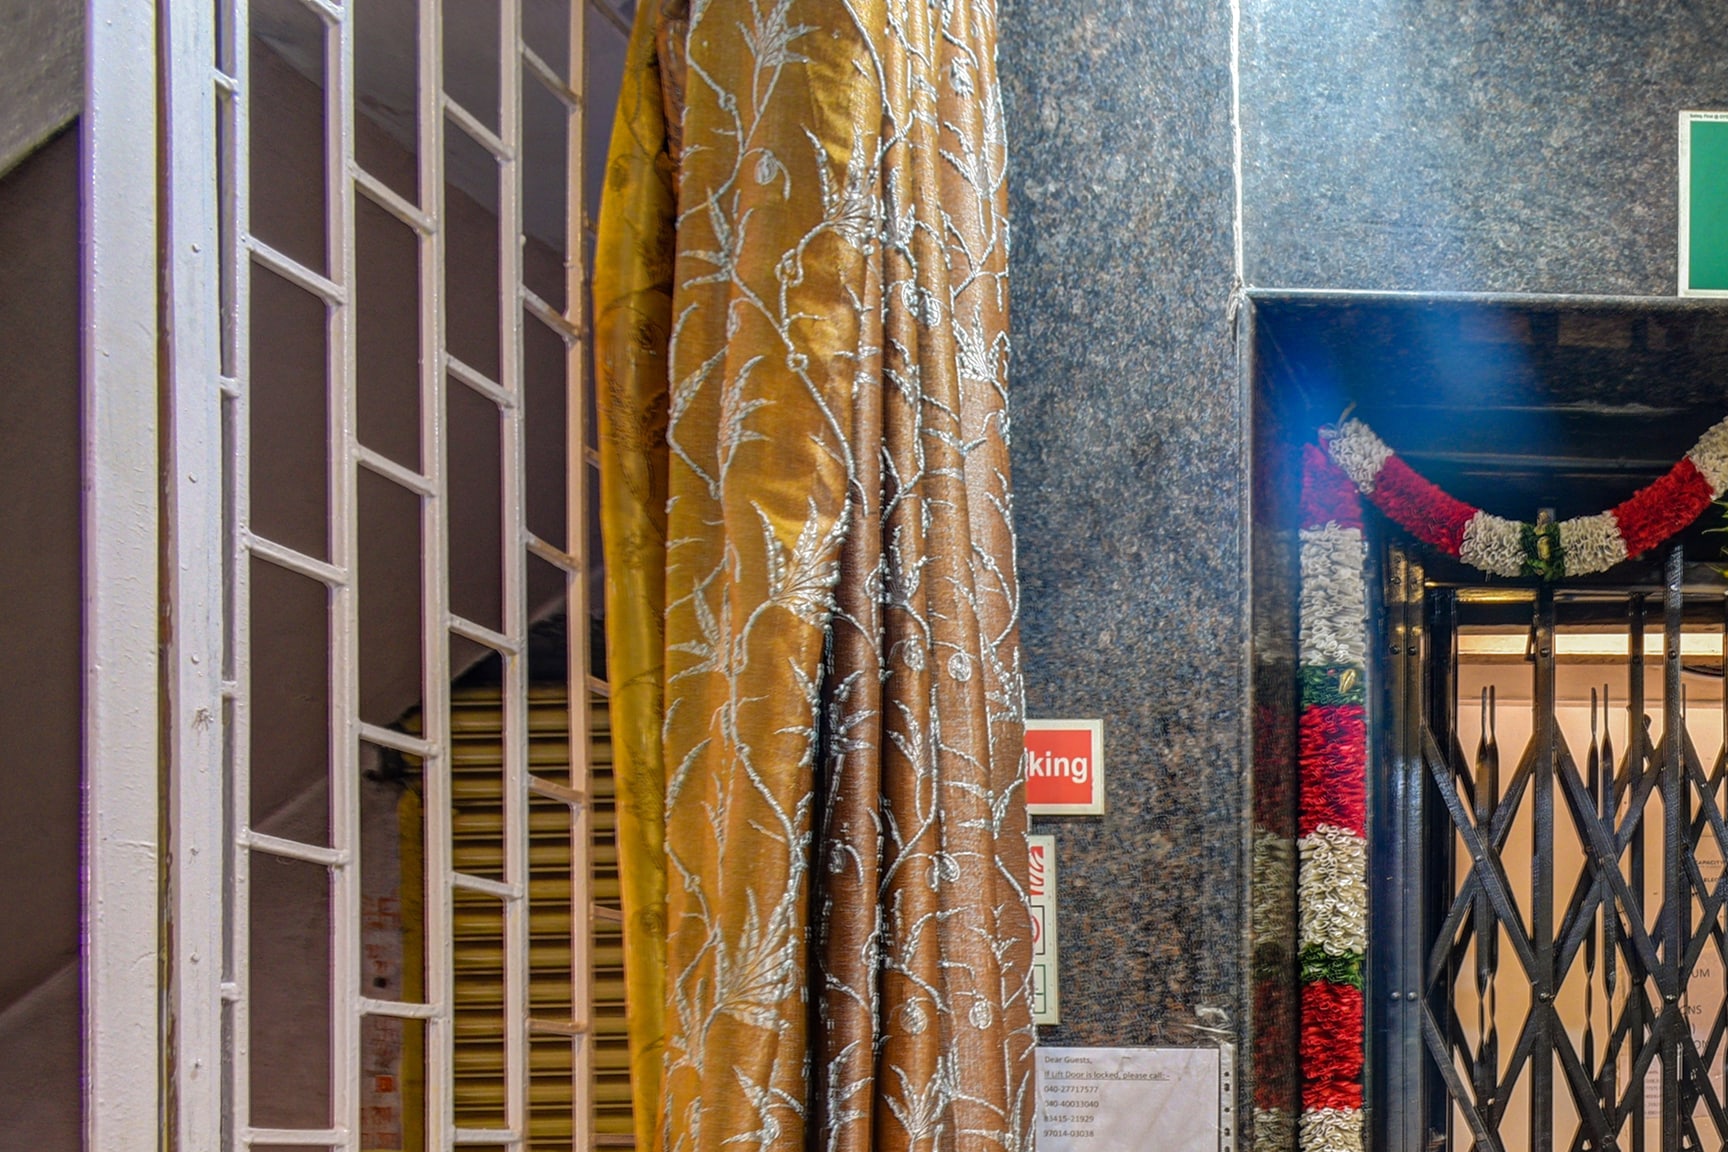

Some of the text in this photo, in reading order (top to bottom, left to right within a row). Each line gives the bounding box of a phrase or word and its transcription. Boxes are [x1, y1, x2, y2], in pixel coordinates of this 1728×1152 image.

[1064, 1056, 1093, 1064] Guests,
[1044, 1071, 1050, 1079] If
[1051, 1071, 1064, 1079] Lift
[1065, 1071, 1084, 1079] Door
[1086, 1071, 1092, 1079] is
[1094, 1071, 1121, 1080] locked,
[1123, 1071, 1148, 1080] please
